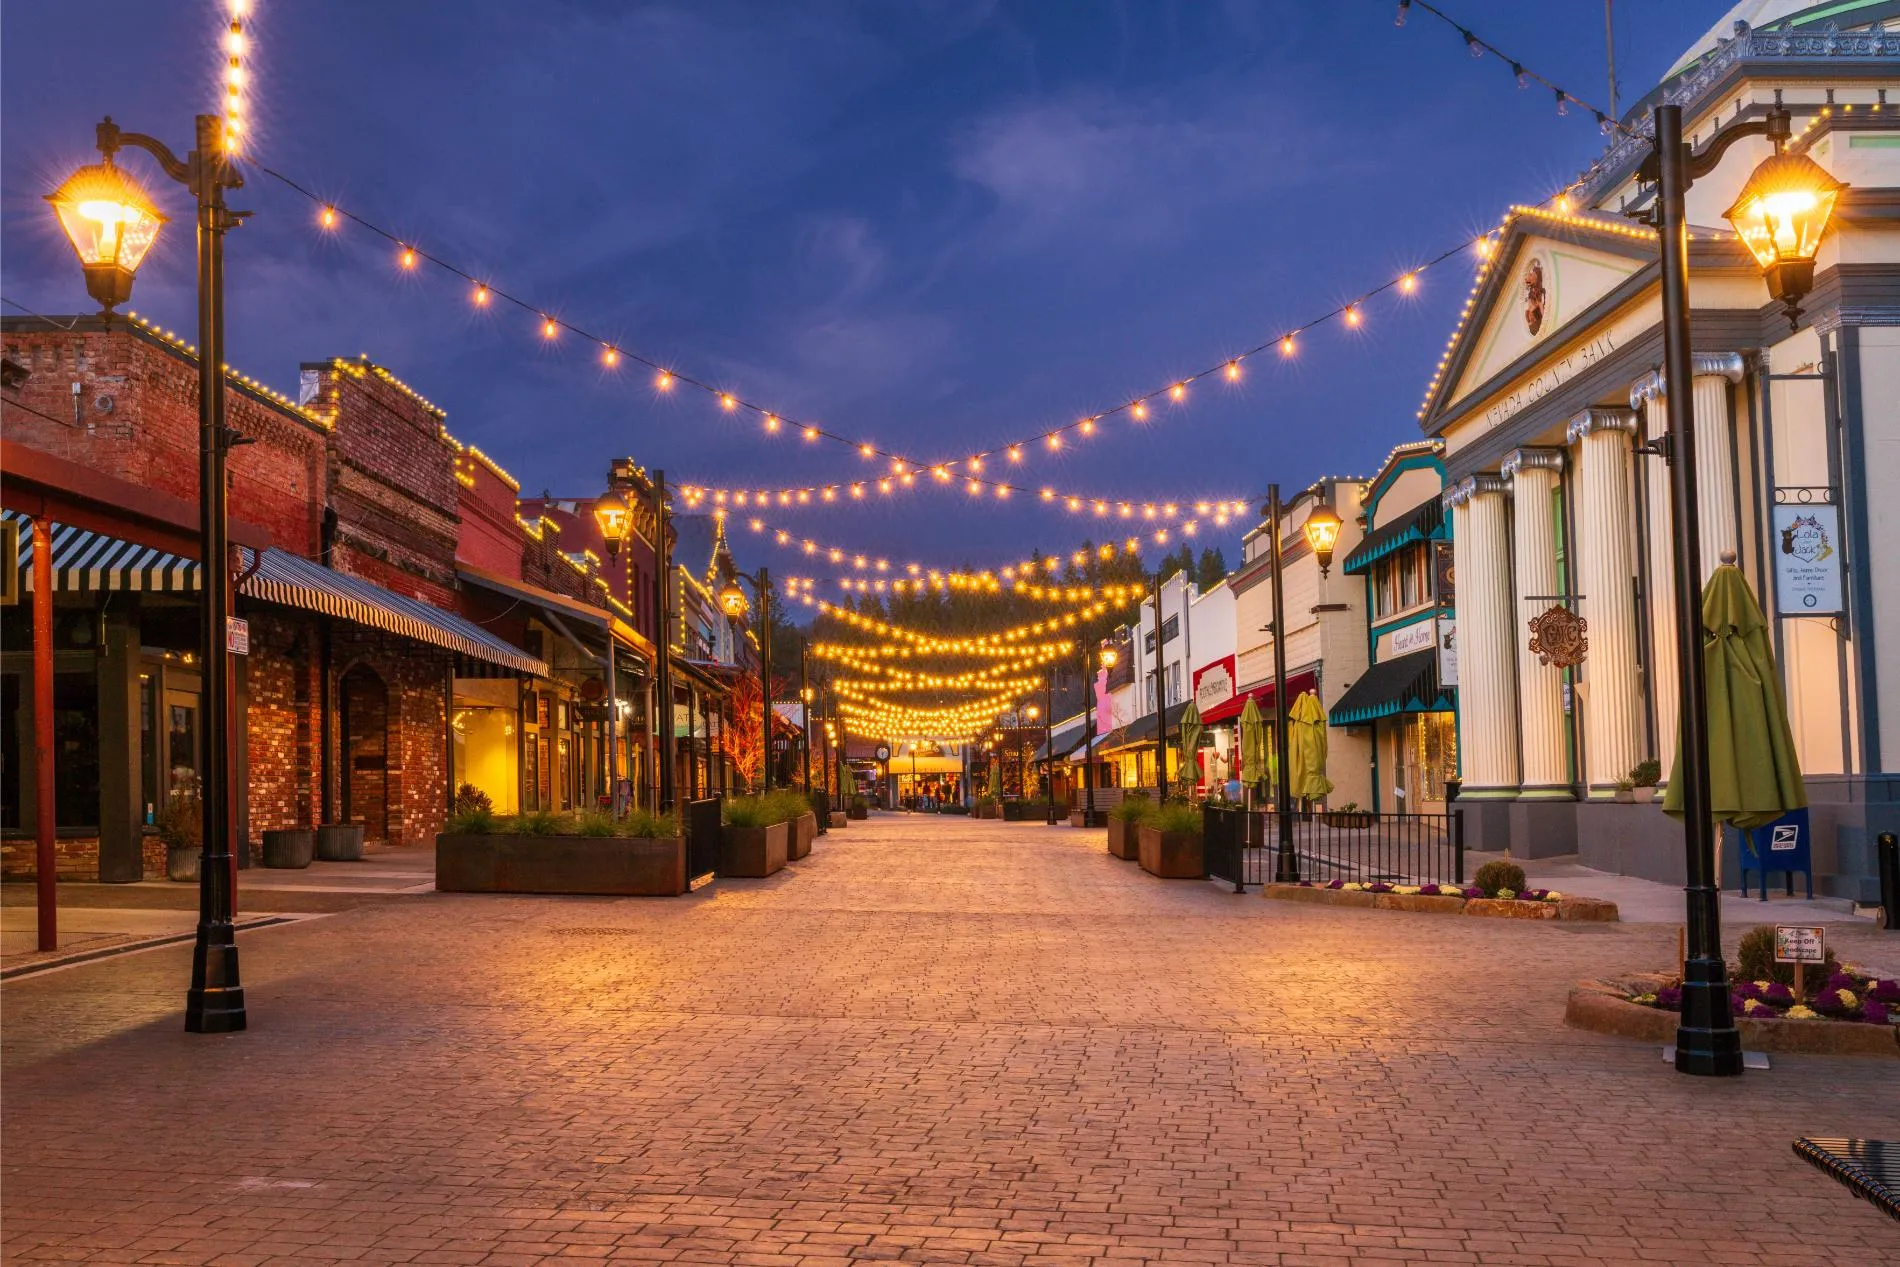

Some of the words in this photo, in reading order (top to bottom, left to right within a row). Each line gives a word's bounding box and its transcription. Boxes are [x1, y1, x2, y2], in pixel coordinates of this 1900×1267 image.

[1581, 328, 1616, 370] BANK
[1796, 529, 1819, 540] Lola
[1795, 545, 1817, 555] Jack
